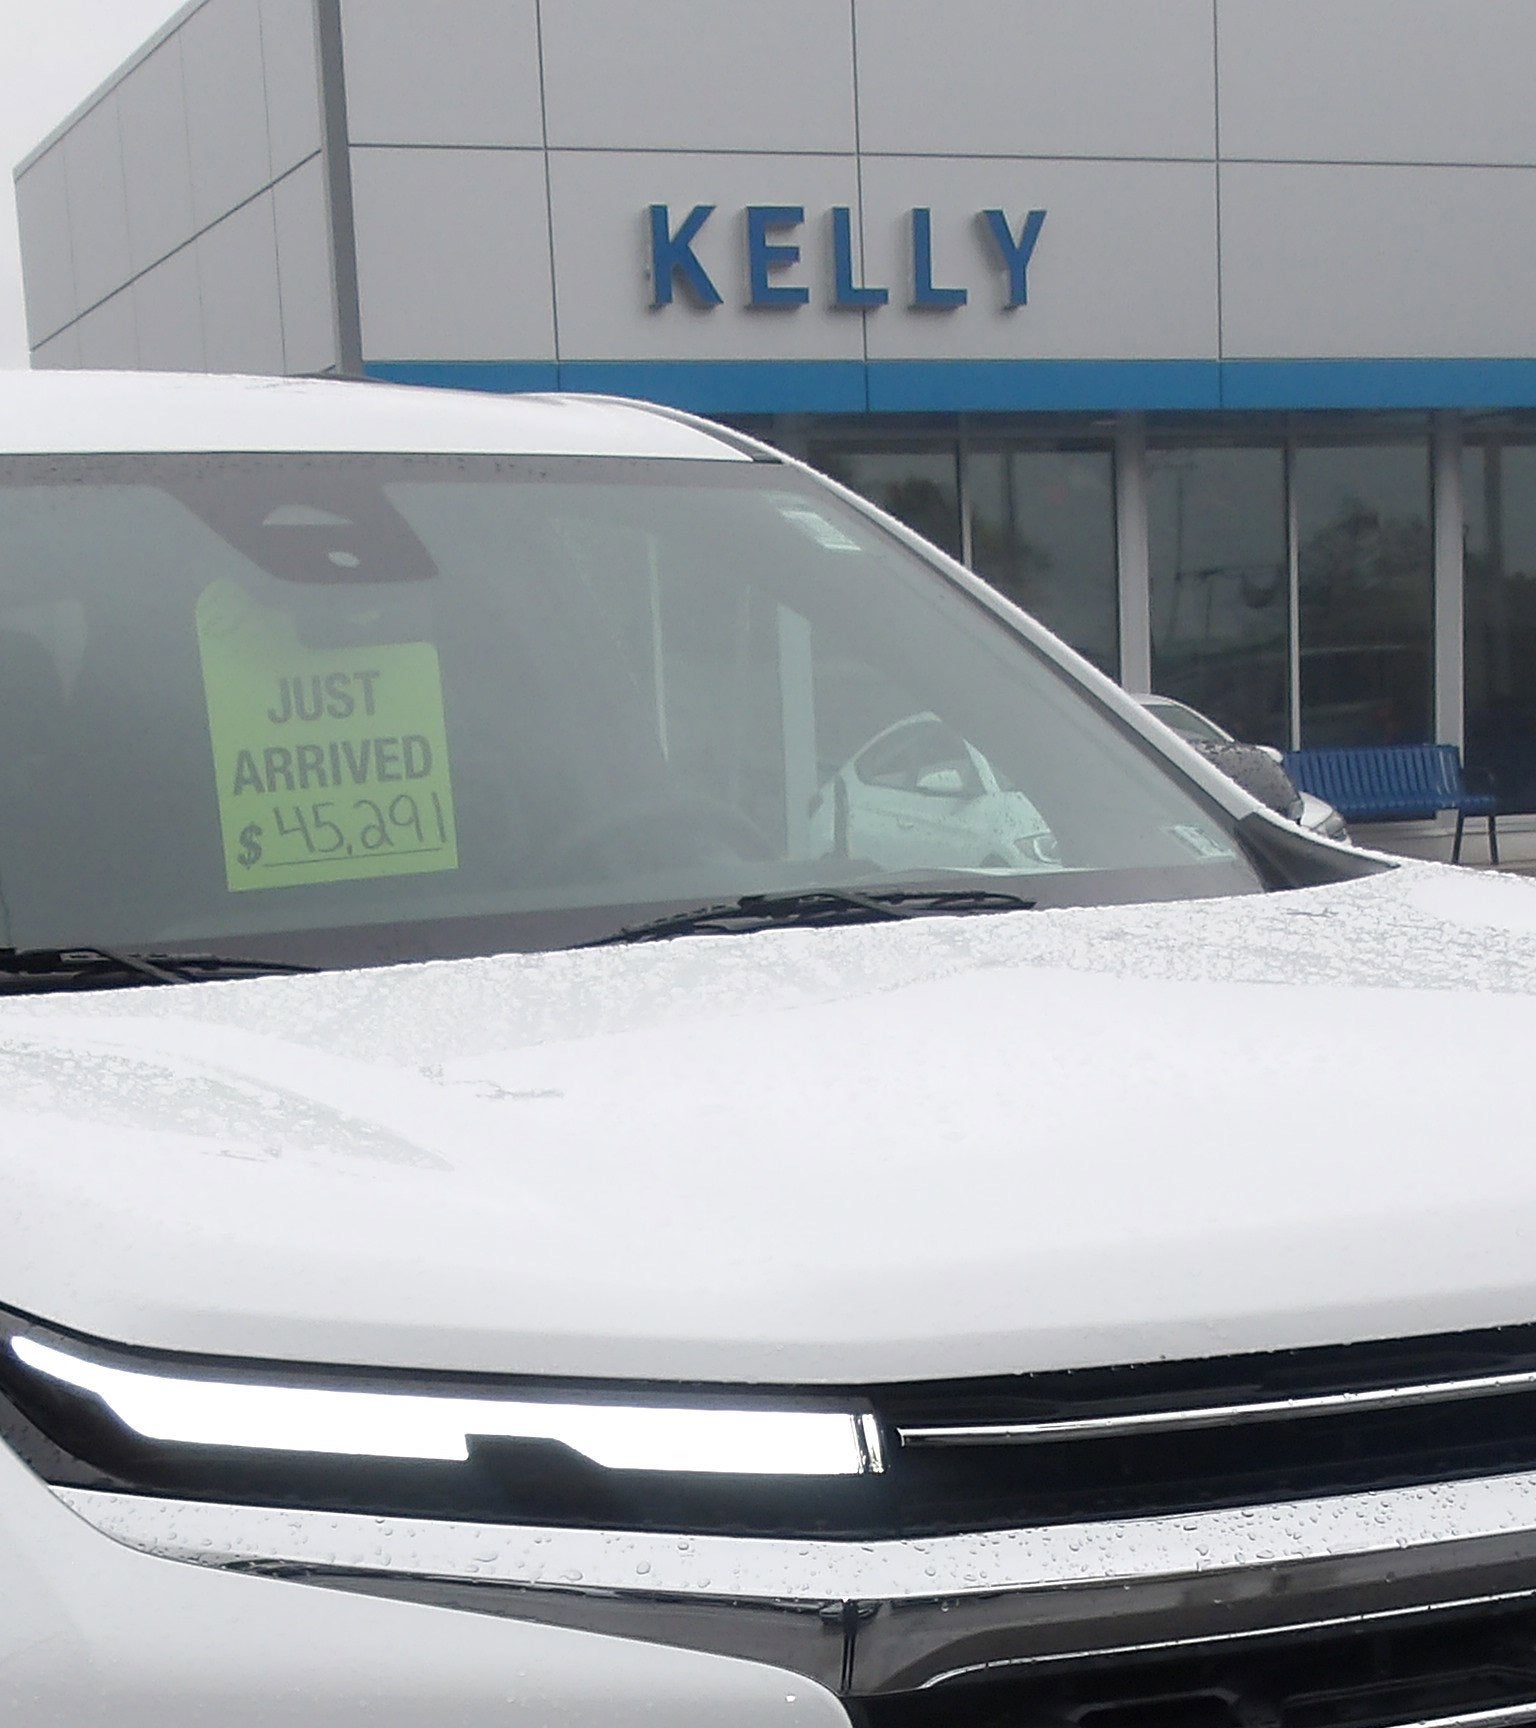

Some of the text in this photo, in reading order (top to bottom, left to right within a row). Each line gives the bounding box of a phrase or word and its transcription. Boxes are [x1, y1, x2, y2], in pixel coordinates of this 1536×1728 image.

[648, 204, 1048, 307] KELLY
[267, 670, 381, 724] JUST
[232, 734, 434, 796] ARRIVED
